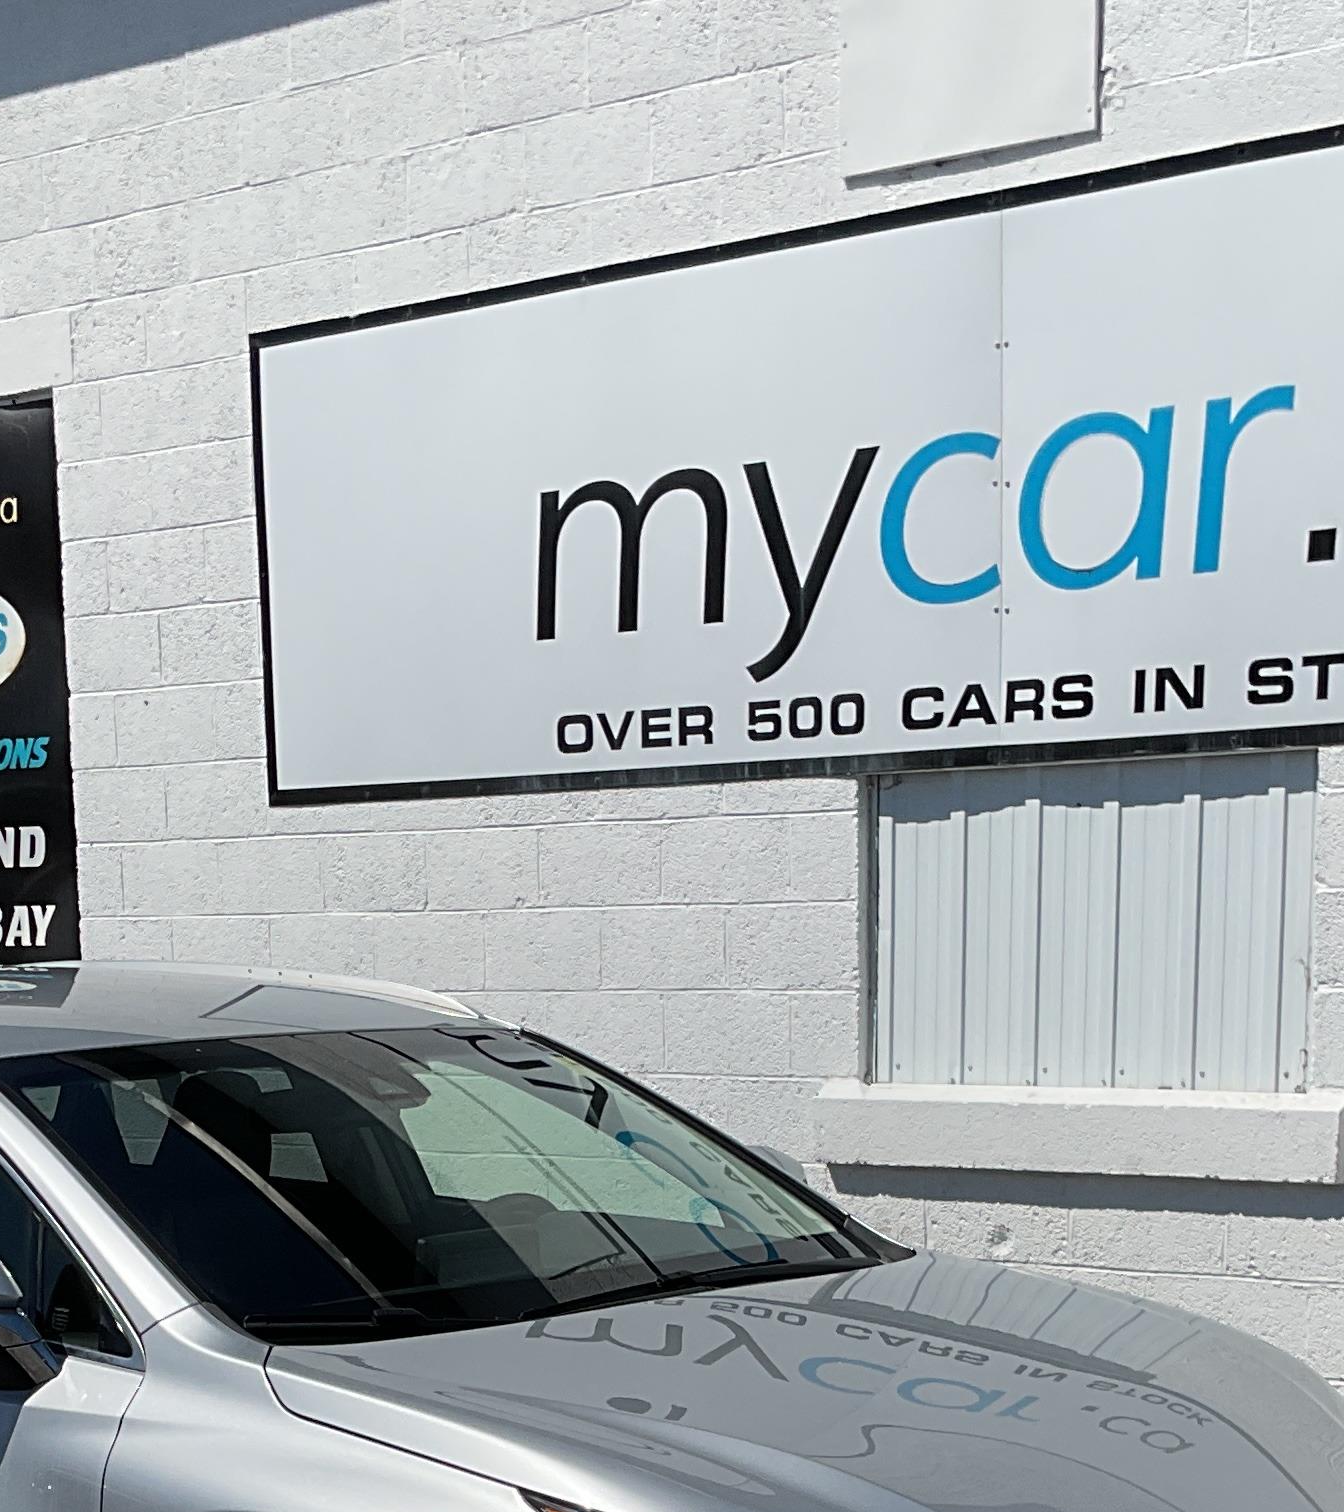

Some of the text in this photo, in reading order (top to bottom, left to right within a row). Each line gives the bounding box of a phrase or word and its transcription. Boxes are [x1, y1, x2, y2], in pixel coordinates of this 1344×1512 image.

[557, 705, 714, 754] OVER
[747, 693, 865, 742] 500
[901, 674, 1094, 731] CARS
[1133, 665, 1206, 714] IN
